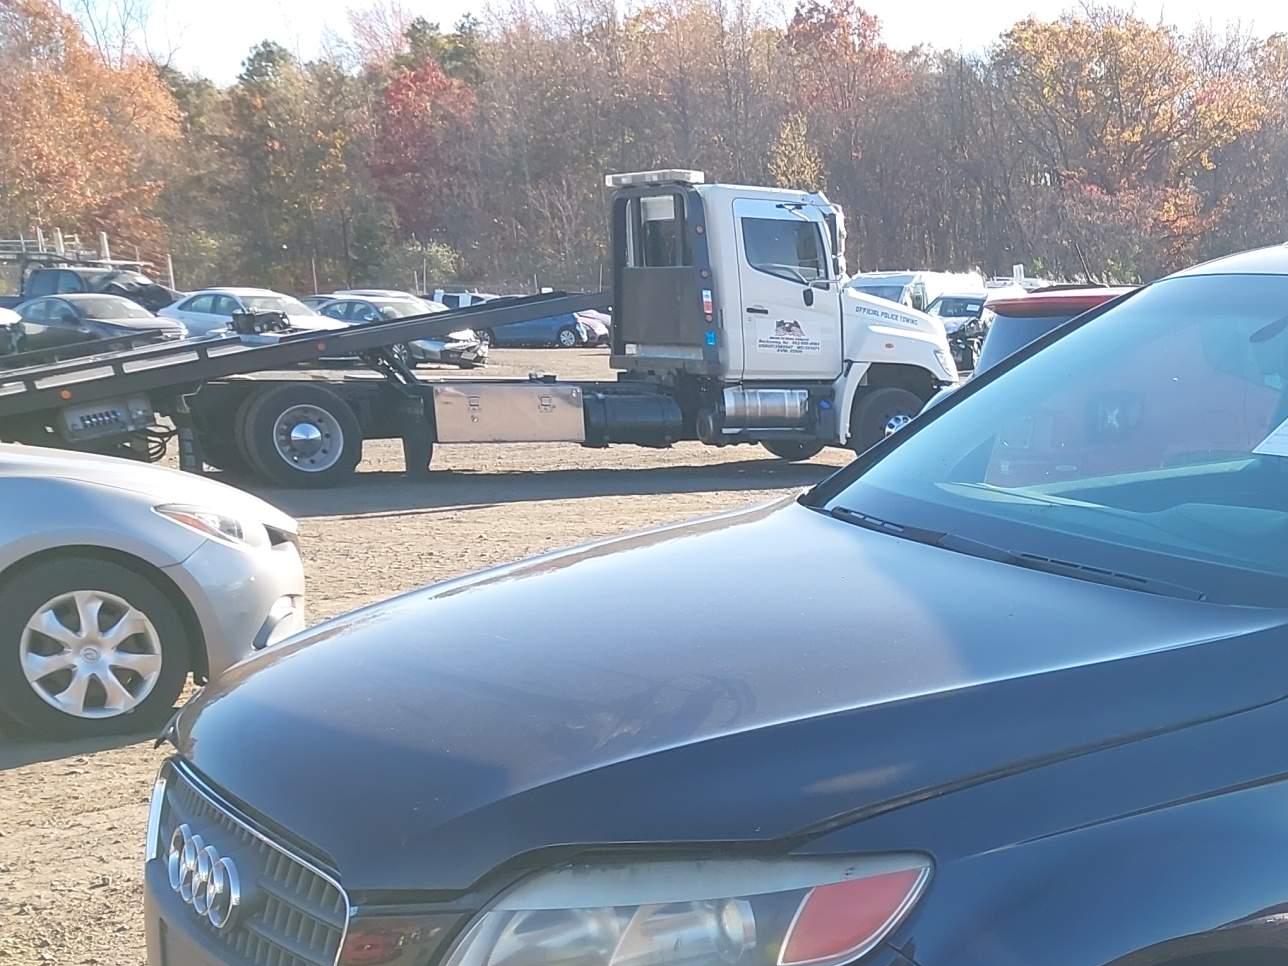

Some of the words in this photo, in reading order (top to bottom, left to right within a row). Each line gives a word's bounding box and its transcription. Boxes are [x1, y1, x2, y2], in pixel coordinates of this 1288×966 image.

[855, 305, 880, 317] OFFICIAL
[881, 311, 899, 322] POLICE
[900, 315, 919, 326] TOWING
